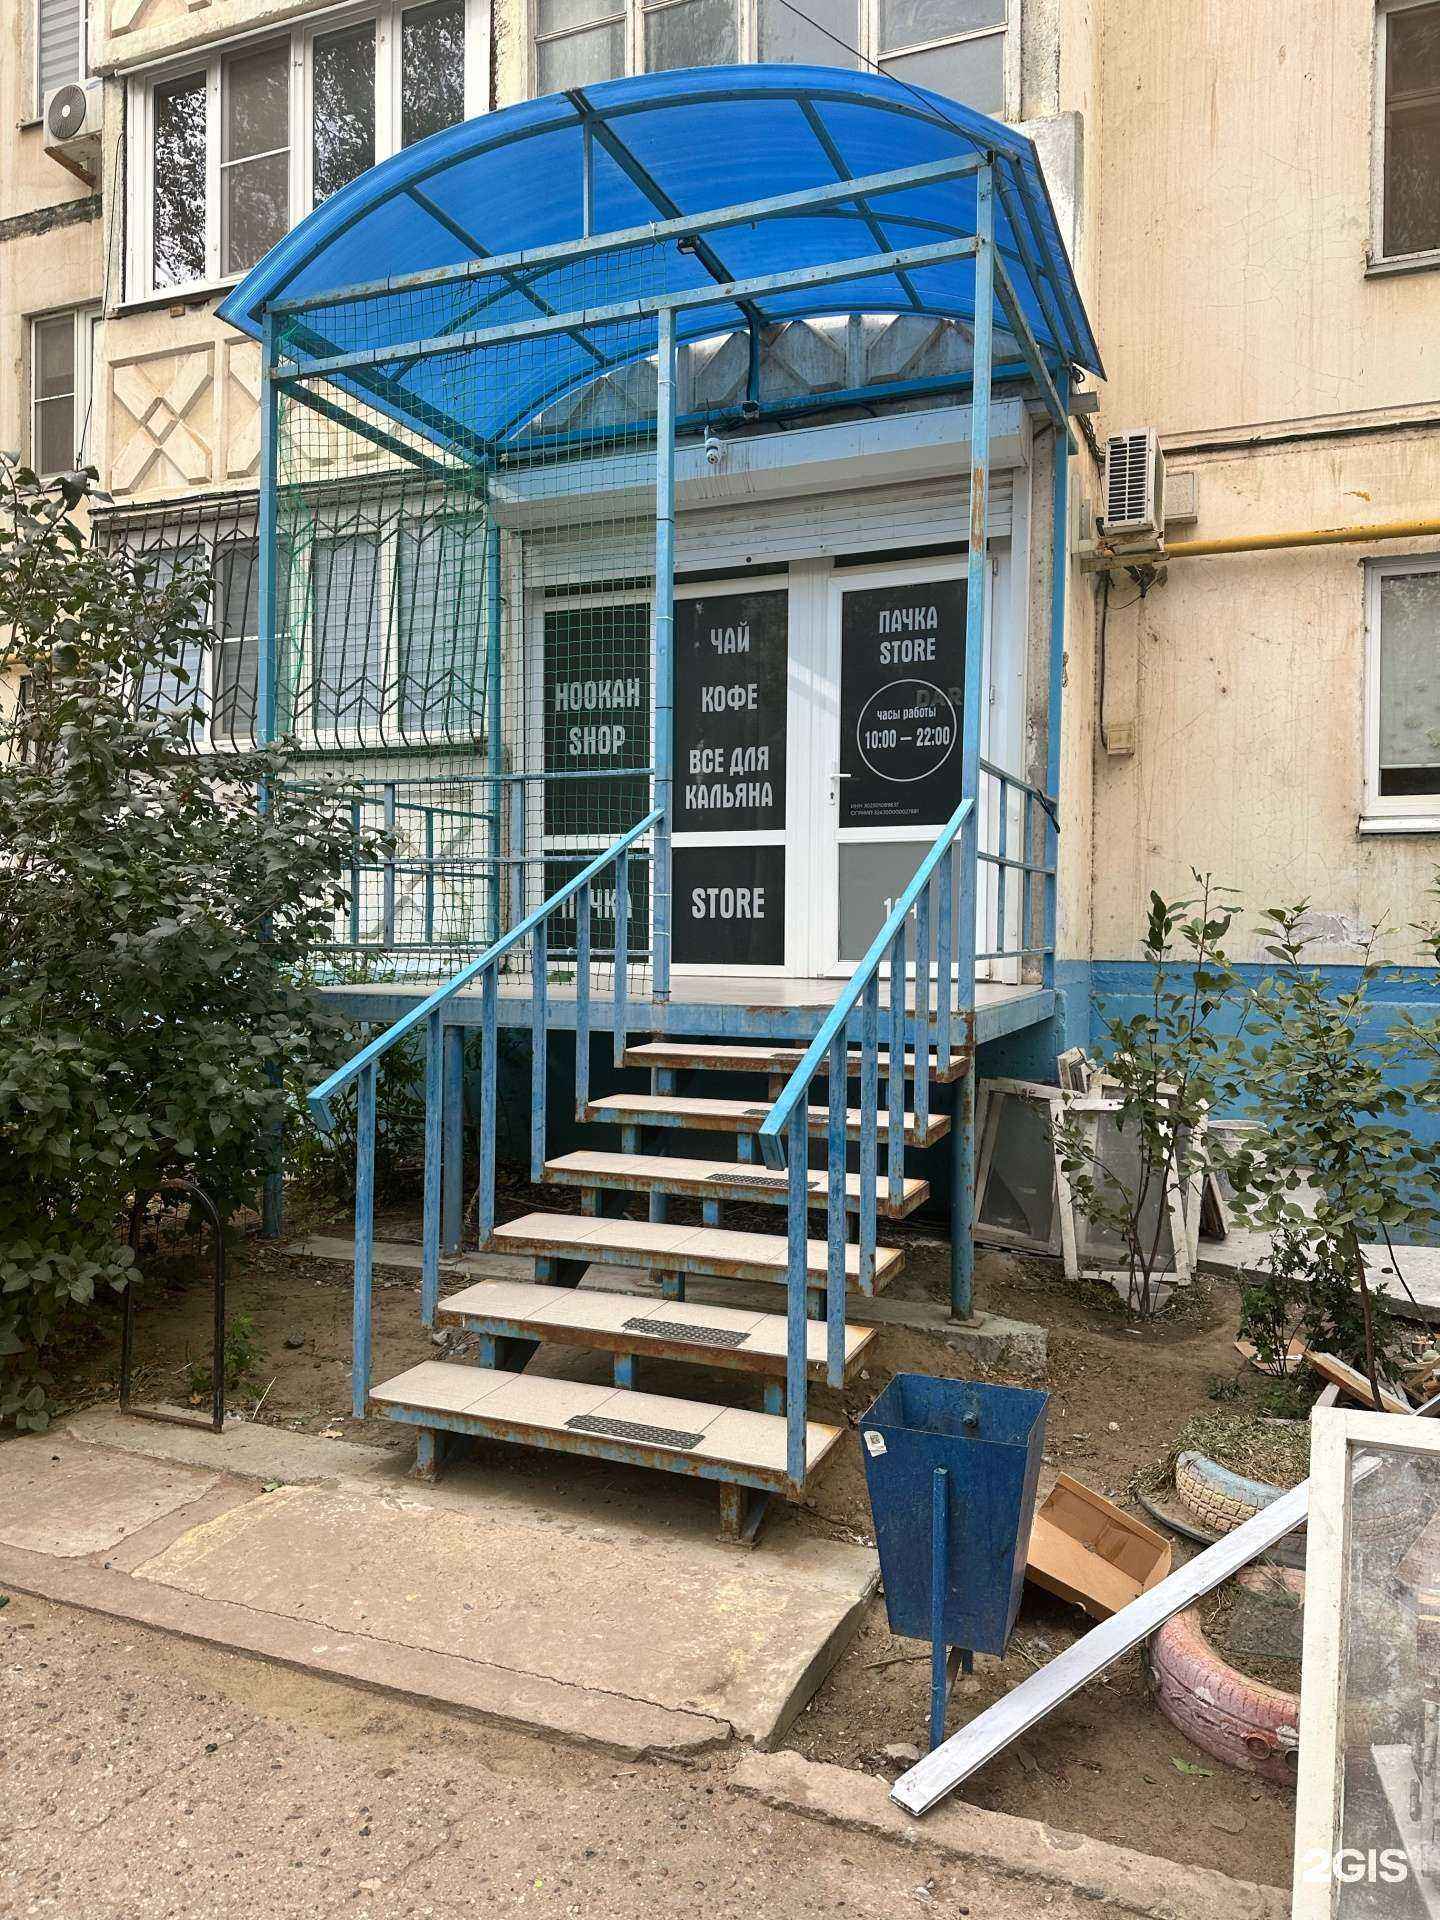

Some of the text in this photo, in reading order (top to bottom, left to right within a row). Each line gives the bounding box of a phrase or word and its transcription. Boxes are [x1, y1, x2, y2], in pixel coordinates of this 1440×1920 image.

[878, 606, 939, 634] ПАЧКА
[710, 620, 750, 655] ЧАЙ
[879, 637, 937, 665] STORE
[555, 677, 640, 711] HOOKAH
[701, 683, 758, 713] КОФЕ
[877, 706, 937, 721] часы работы
[569, 725, 626, 755] SHOP
[864, 729, 897, 750] 10:00
[916, 726, 951, 747] 22:00
[689, 745, 769, 777] ВСЕ ДЛЯ
[685, 782, 773, 810] КАЛЬЯНА
[691, 887, 765, 919] STORE
